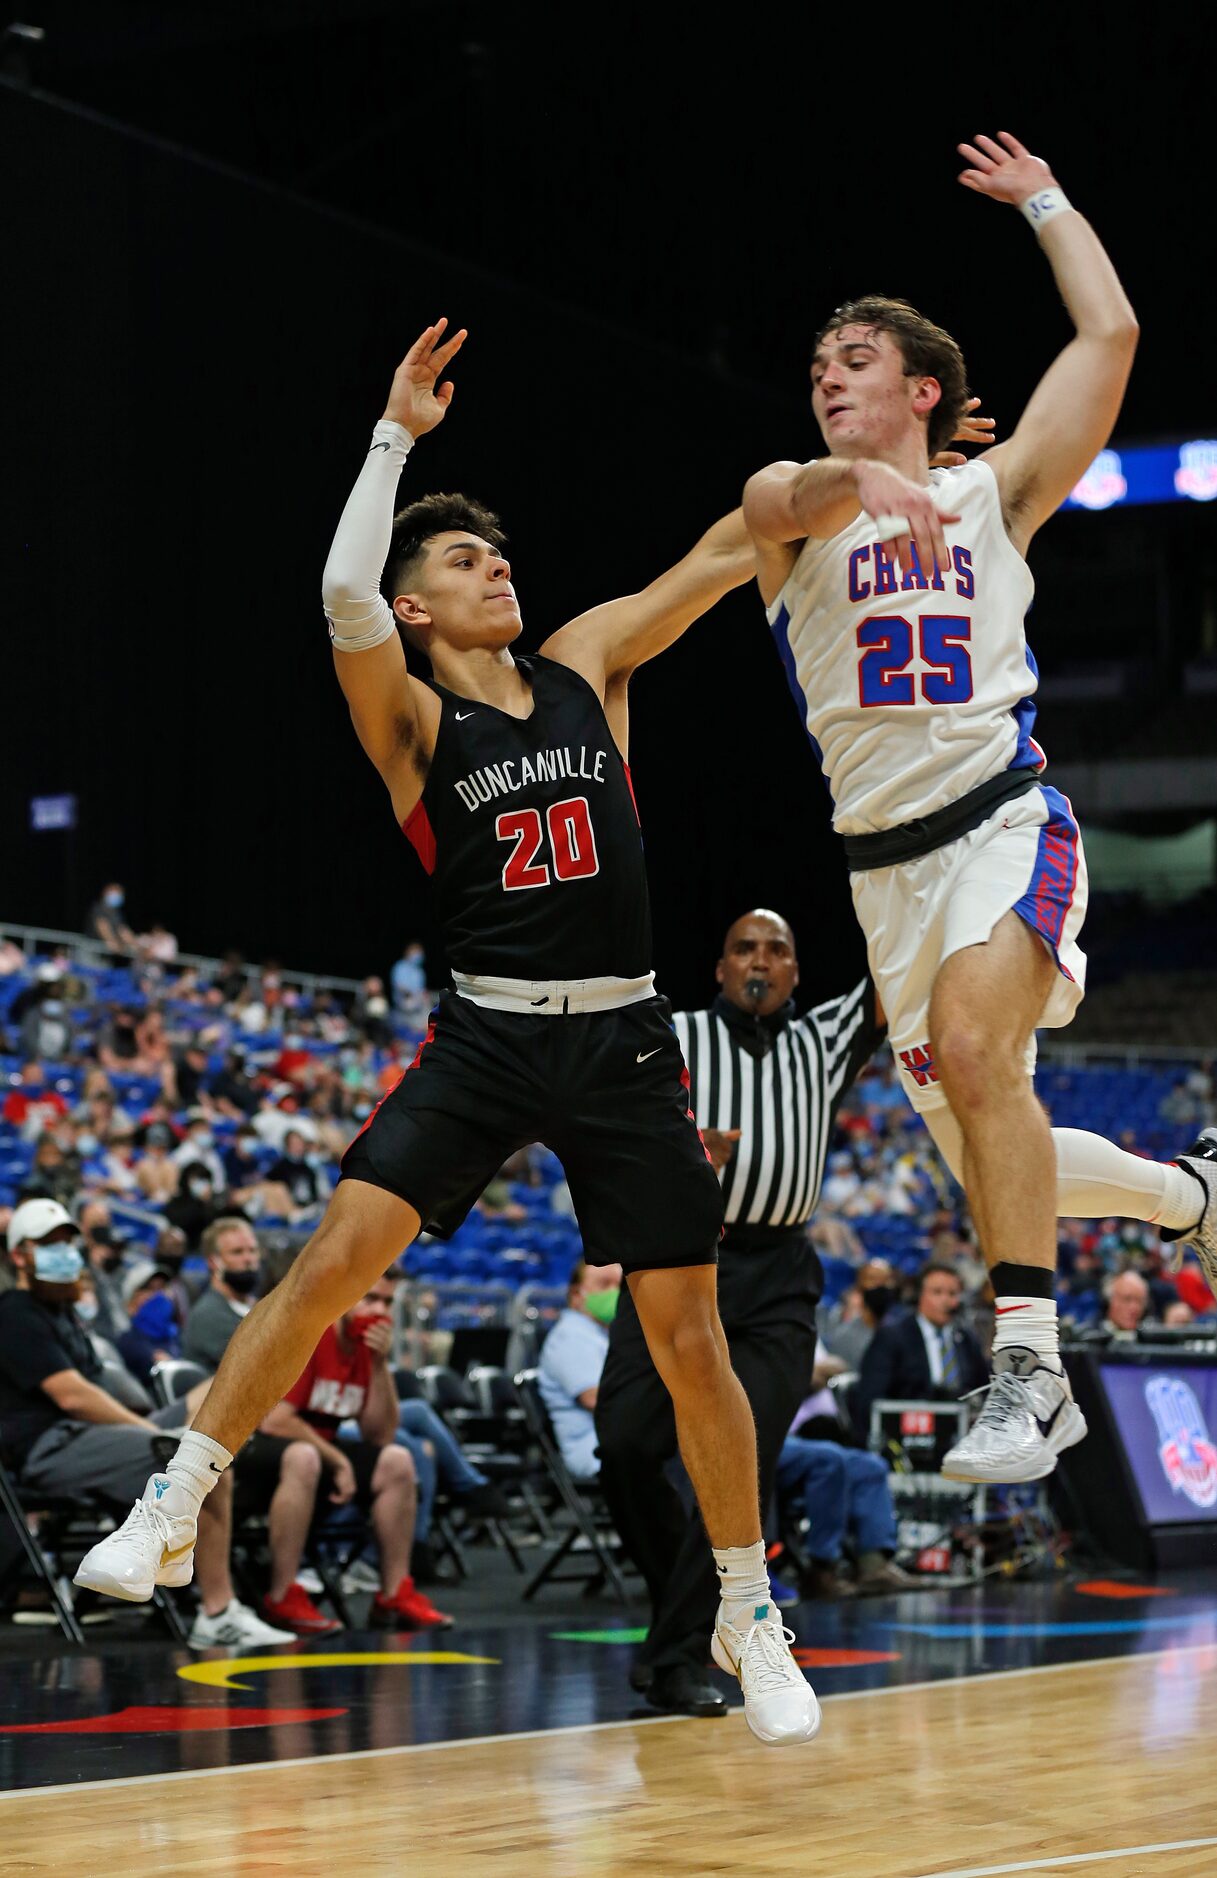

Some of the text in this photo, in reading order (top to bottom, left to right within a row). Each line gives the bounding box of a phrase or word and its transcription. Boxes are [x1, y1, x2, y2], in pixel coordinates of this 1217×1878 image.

[1029, 193, 1056, 219] JC
[856, 615, 974, 708] 25
[454, 746, 607, 812] DUNCANVILLE
[495, 796, 600, 891] 20
